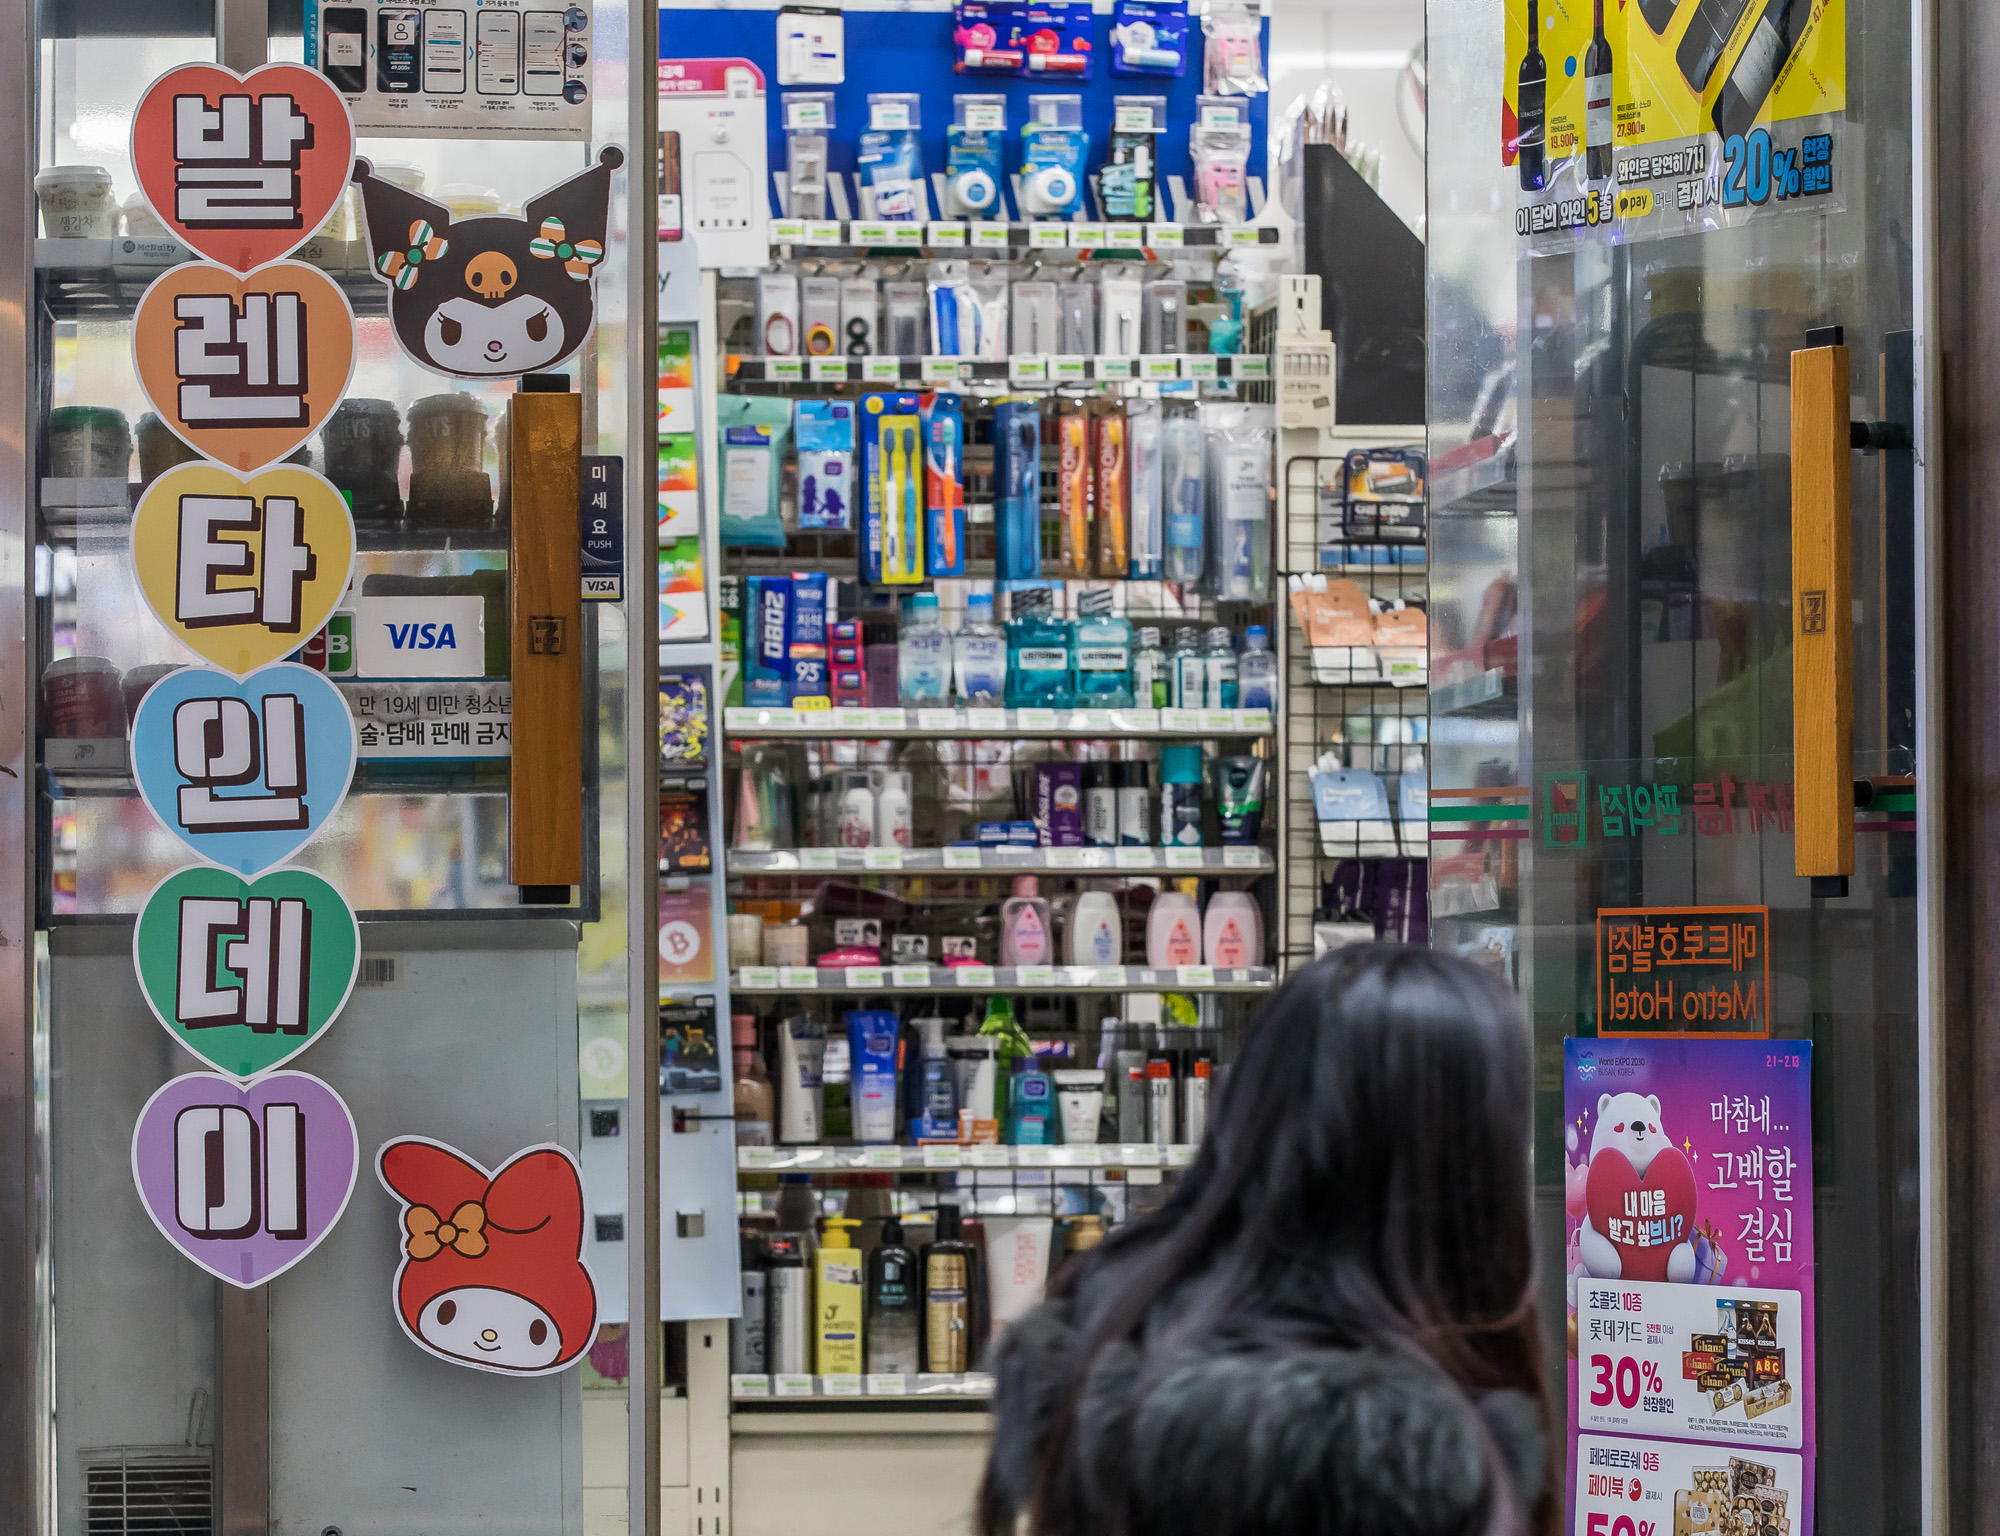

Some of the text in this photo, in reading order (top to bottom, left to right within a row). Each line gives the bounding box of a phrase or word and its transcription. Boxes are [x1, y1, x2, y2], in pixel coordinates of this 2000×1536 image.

[1802, 134, 1832, 163] 현장
[1617, 157, 1649, 184] 와인은
[1652, 153, 1684, 180] 당연히
[1723, 128, 1802, 208] 20%
[1803, 164, 1832, 195] 할인
[1630, 194, 1647, 212] pay
[1655, 189, 1674, 210] 머니
[60, 215, 93, 232] 생강차
[137, 244, 176, 254] McNulty
[591, 465, 607, 534] 미세요
[588, 541, 612, 549] PUSH
[585, 581, 615, 591] VISA
[383, 623, 456, 649] VISA
[764, 590, 785, 659] 2080
[359, 696, 377, 716] 만
[384, 696, 421, 716] 19세
[427, 696, 460, 716] 미만
[360, 722, 425, 746] 술·담배
[431, 723, 470, 746] 판매
[1598, 1057, 1645, 1067] World EXPO 2030
[1598, 1068, 1636, 1077] BUSAN, KOREA
[1708, 1145, 1797, 1201] 고백할
[1624, 1190, 1666, 1217] 내 마음
[1608, 1214, 1684, 1247] 받고 싶브니?
[1737, 1207, 1793, 1263] 결심
[1590, 1291, 1642, 1312] 초콜릿 10종
[1590, 1319, 1643, 1343] 롯데카드
[1646, 1323, 1674, 1335] 5천원 이상
[1695, 1339, 1724, 1353] Ghana
[1685, 1359, 1713, 1370] Ghana
[1590, 1354, 1663, 1409] 30%
[1700, 1375, 1728, 1388] Ghana
[1643, 1396, 1674, 1414] 현장할인
[1589, 1447, 1660, 1471] 페레로로쉐 9종
[1588, 1474, 1624, 1499] 페이북
